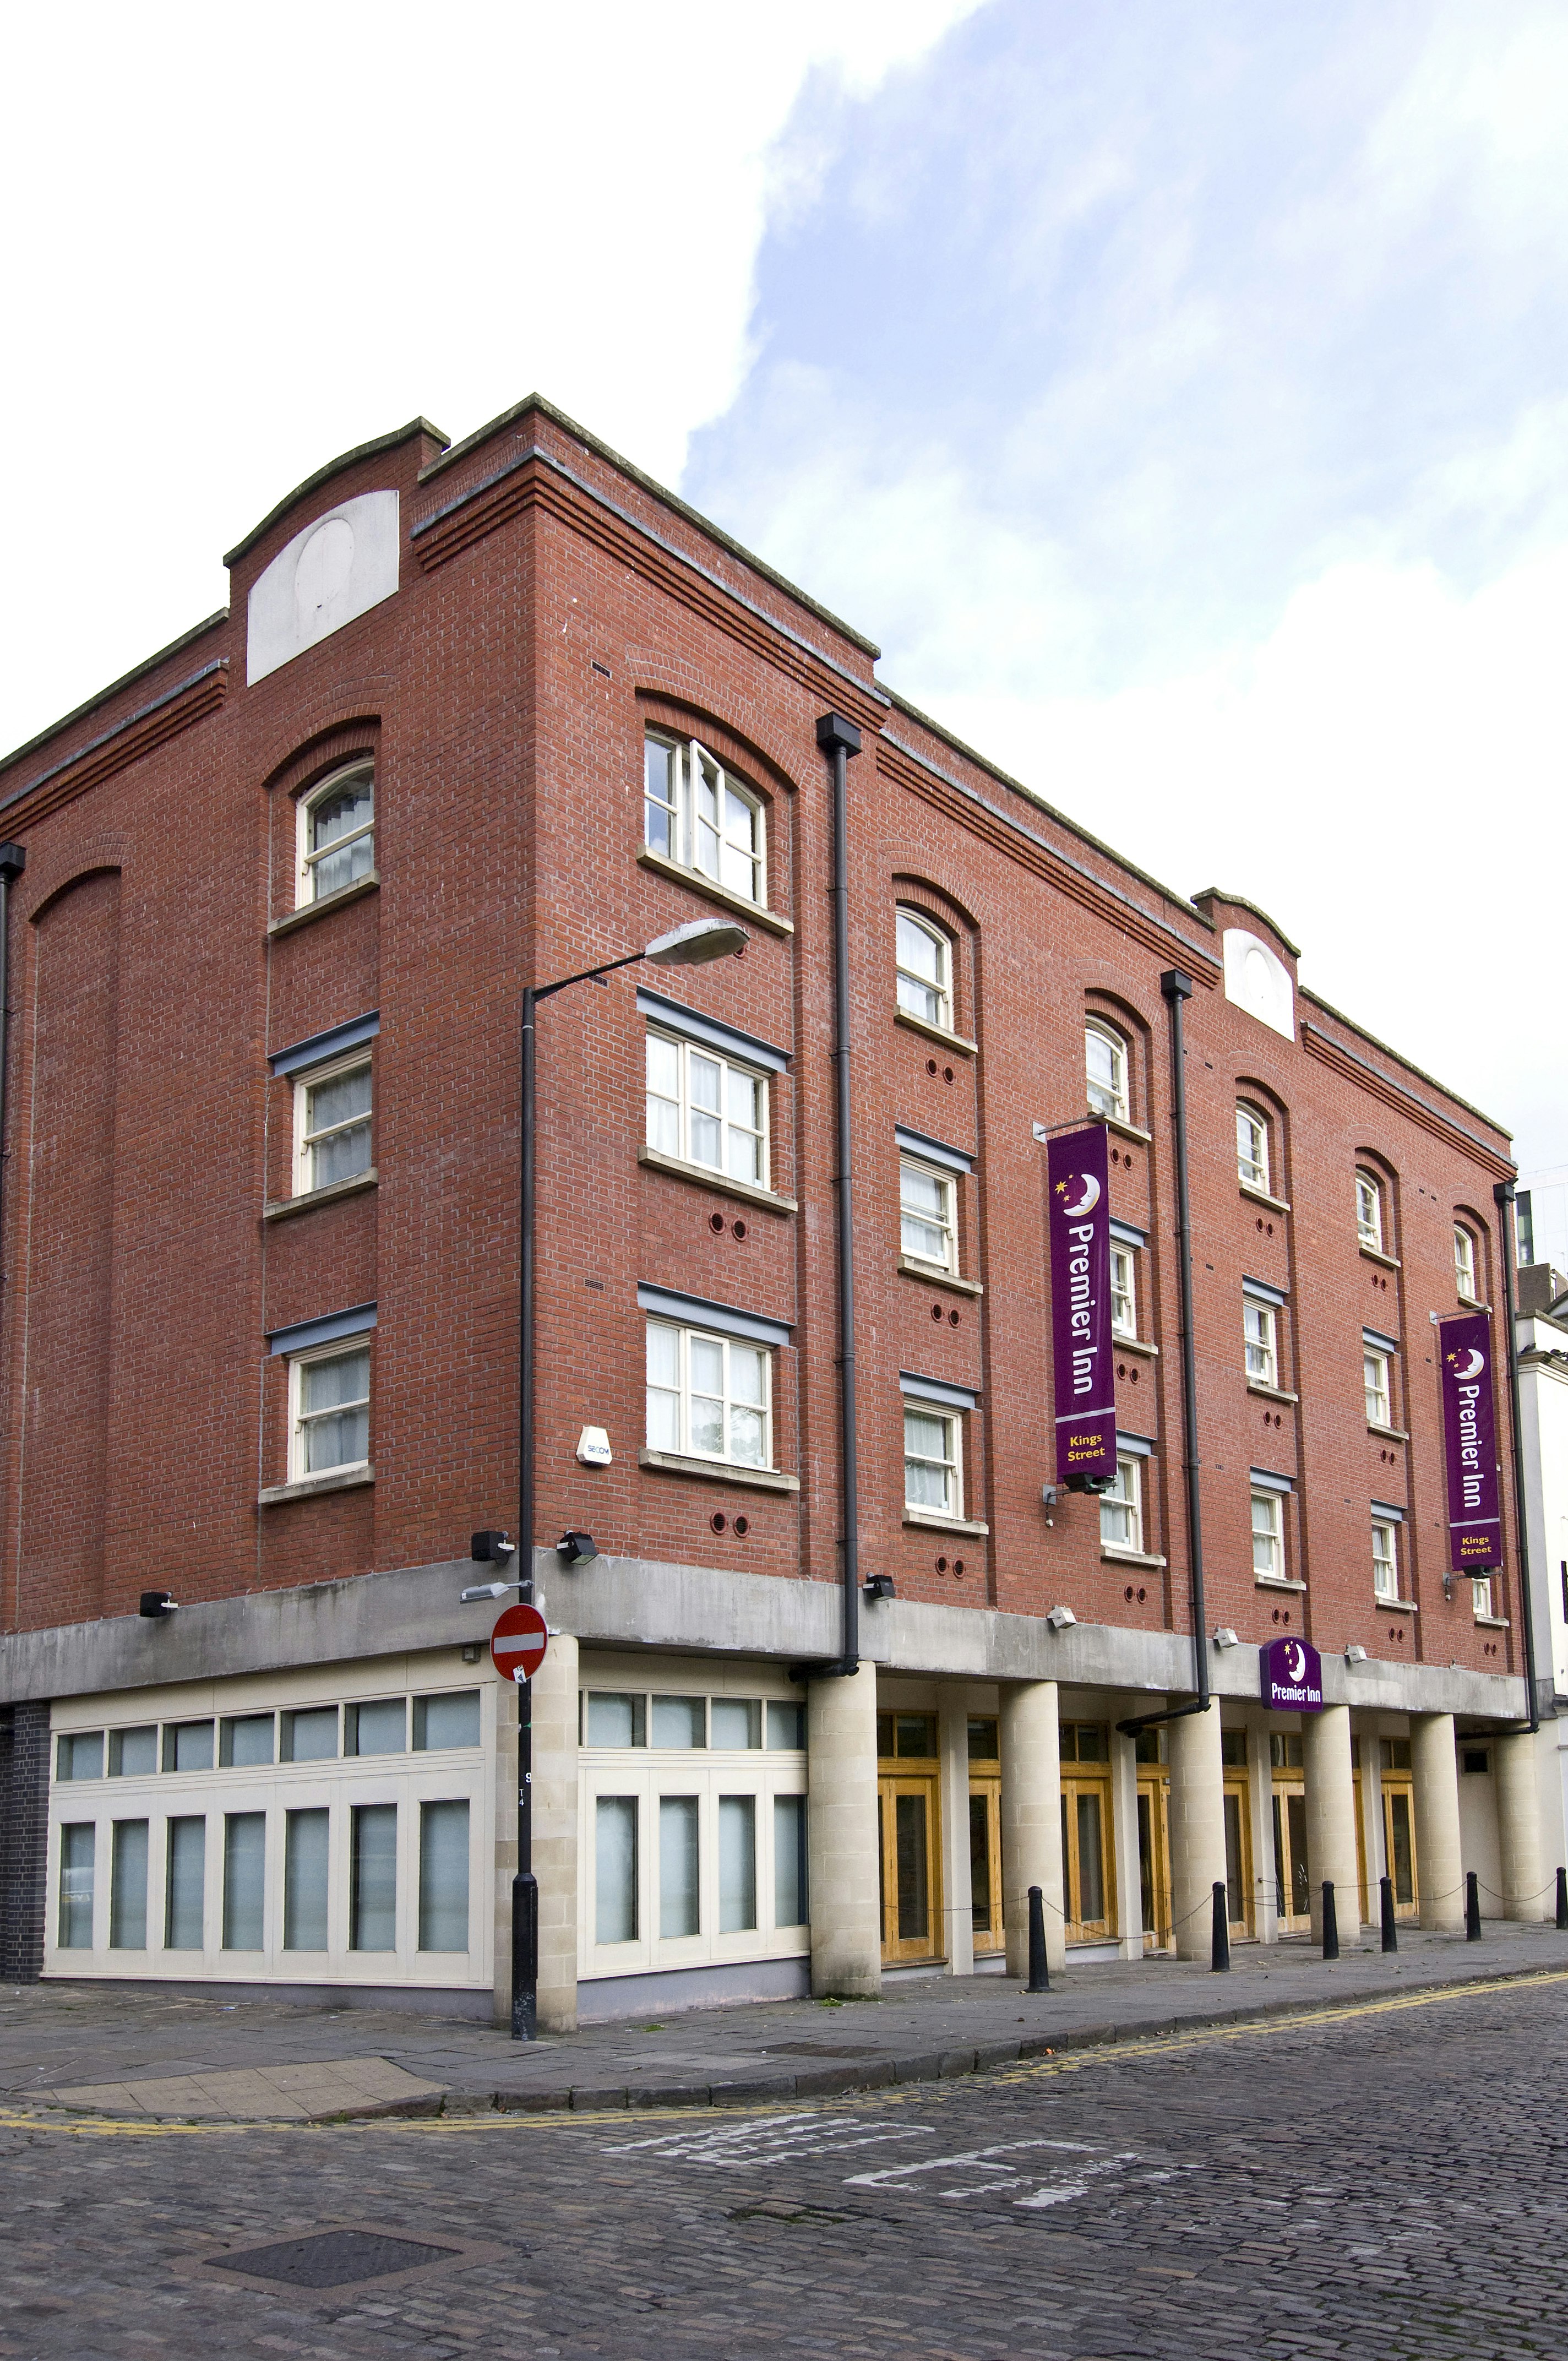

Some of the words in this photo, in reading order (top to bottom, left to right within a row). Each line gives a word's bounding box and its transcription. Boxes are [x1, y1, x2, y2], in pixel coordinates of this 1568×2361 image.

[1069, 1223, 1096, 1341] Premier
[1072, 1346, 1098, 1395] Inn
[1458, 1385, 1483, 1470] Premier
[1070, 1434, 1102, 1447] Kings
[587, 1445, 609, 1455] SECOM
[1068, 1447, 1106, 1462] Street
[1463, 1473, 1484, 1508] Inn
[1462, 1537, 1489, 1545] Kings
[1460, 1546, 1492, 1555] Street
[1271, 1682, 1306, 1701] Premier
[1306, 1685, 1321, 1702] Inn
